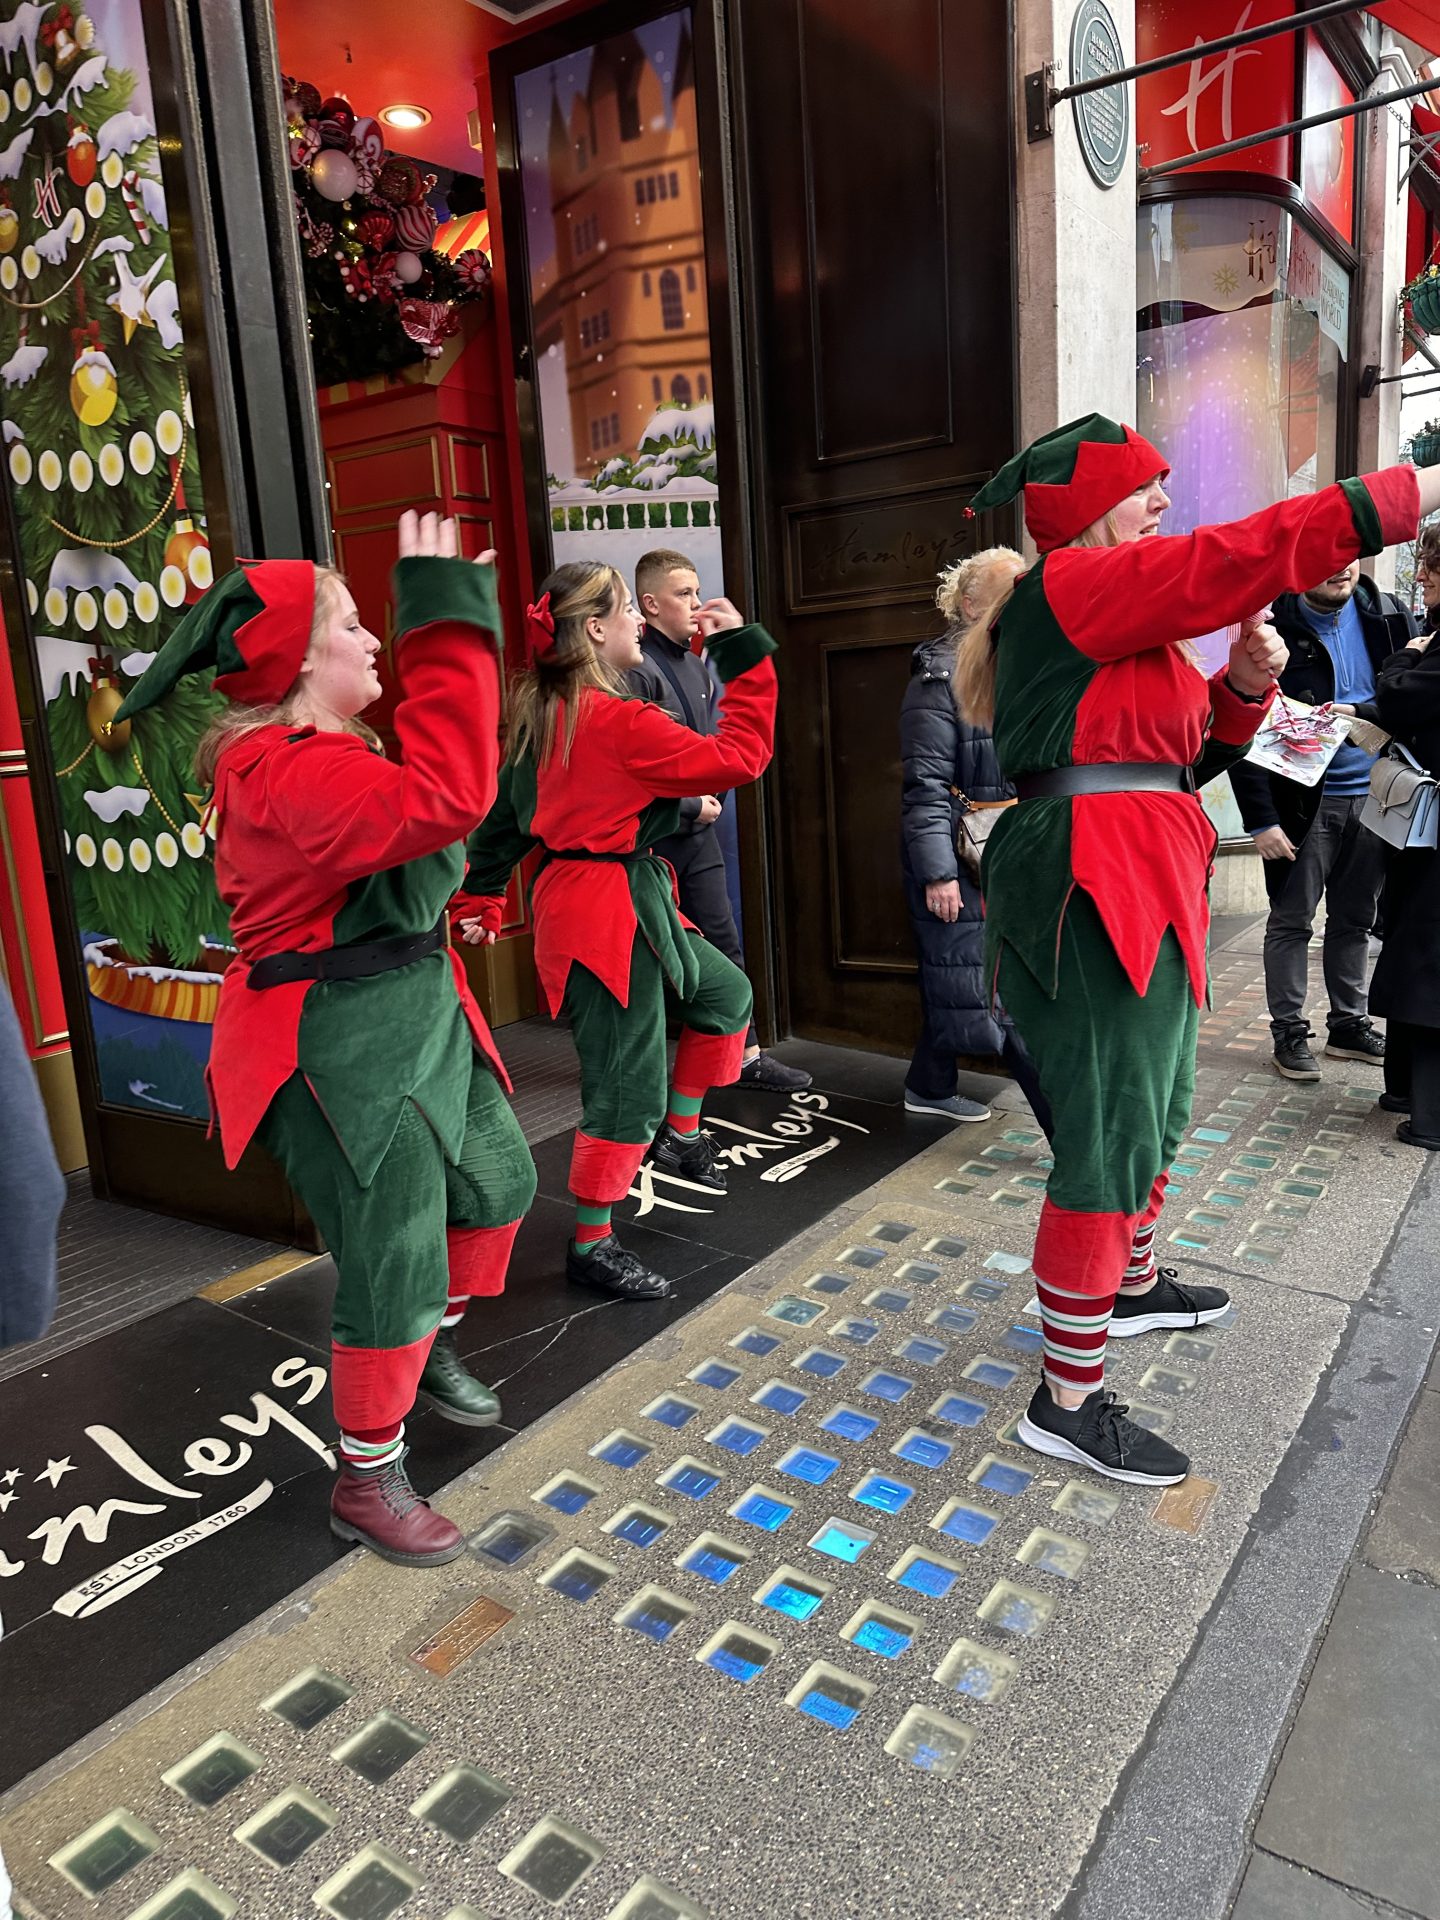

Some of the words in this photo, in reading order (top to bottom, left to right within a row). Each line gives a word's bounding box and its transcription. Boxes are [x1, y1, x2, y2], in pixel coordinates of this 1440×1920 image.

[811, 524, 968, 582] Hamleys
[628, 1091, 870, 1216] Hmleys
[0, 1357, 337, 1577] mleys
[78, 1573, 119, 1598] EST.
[122, 1528, 203, 1571] LONDON
[208, 1504, 248, 1529] 1760
